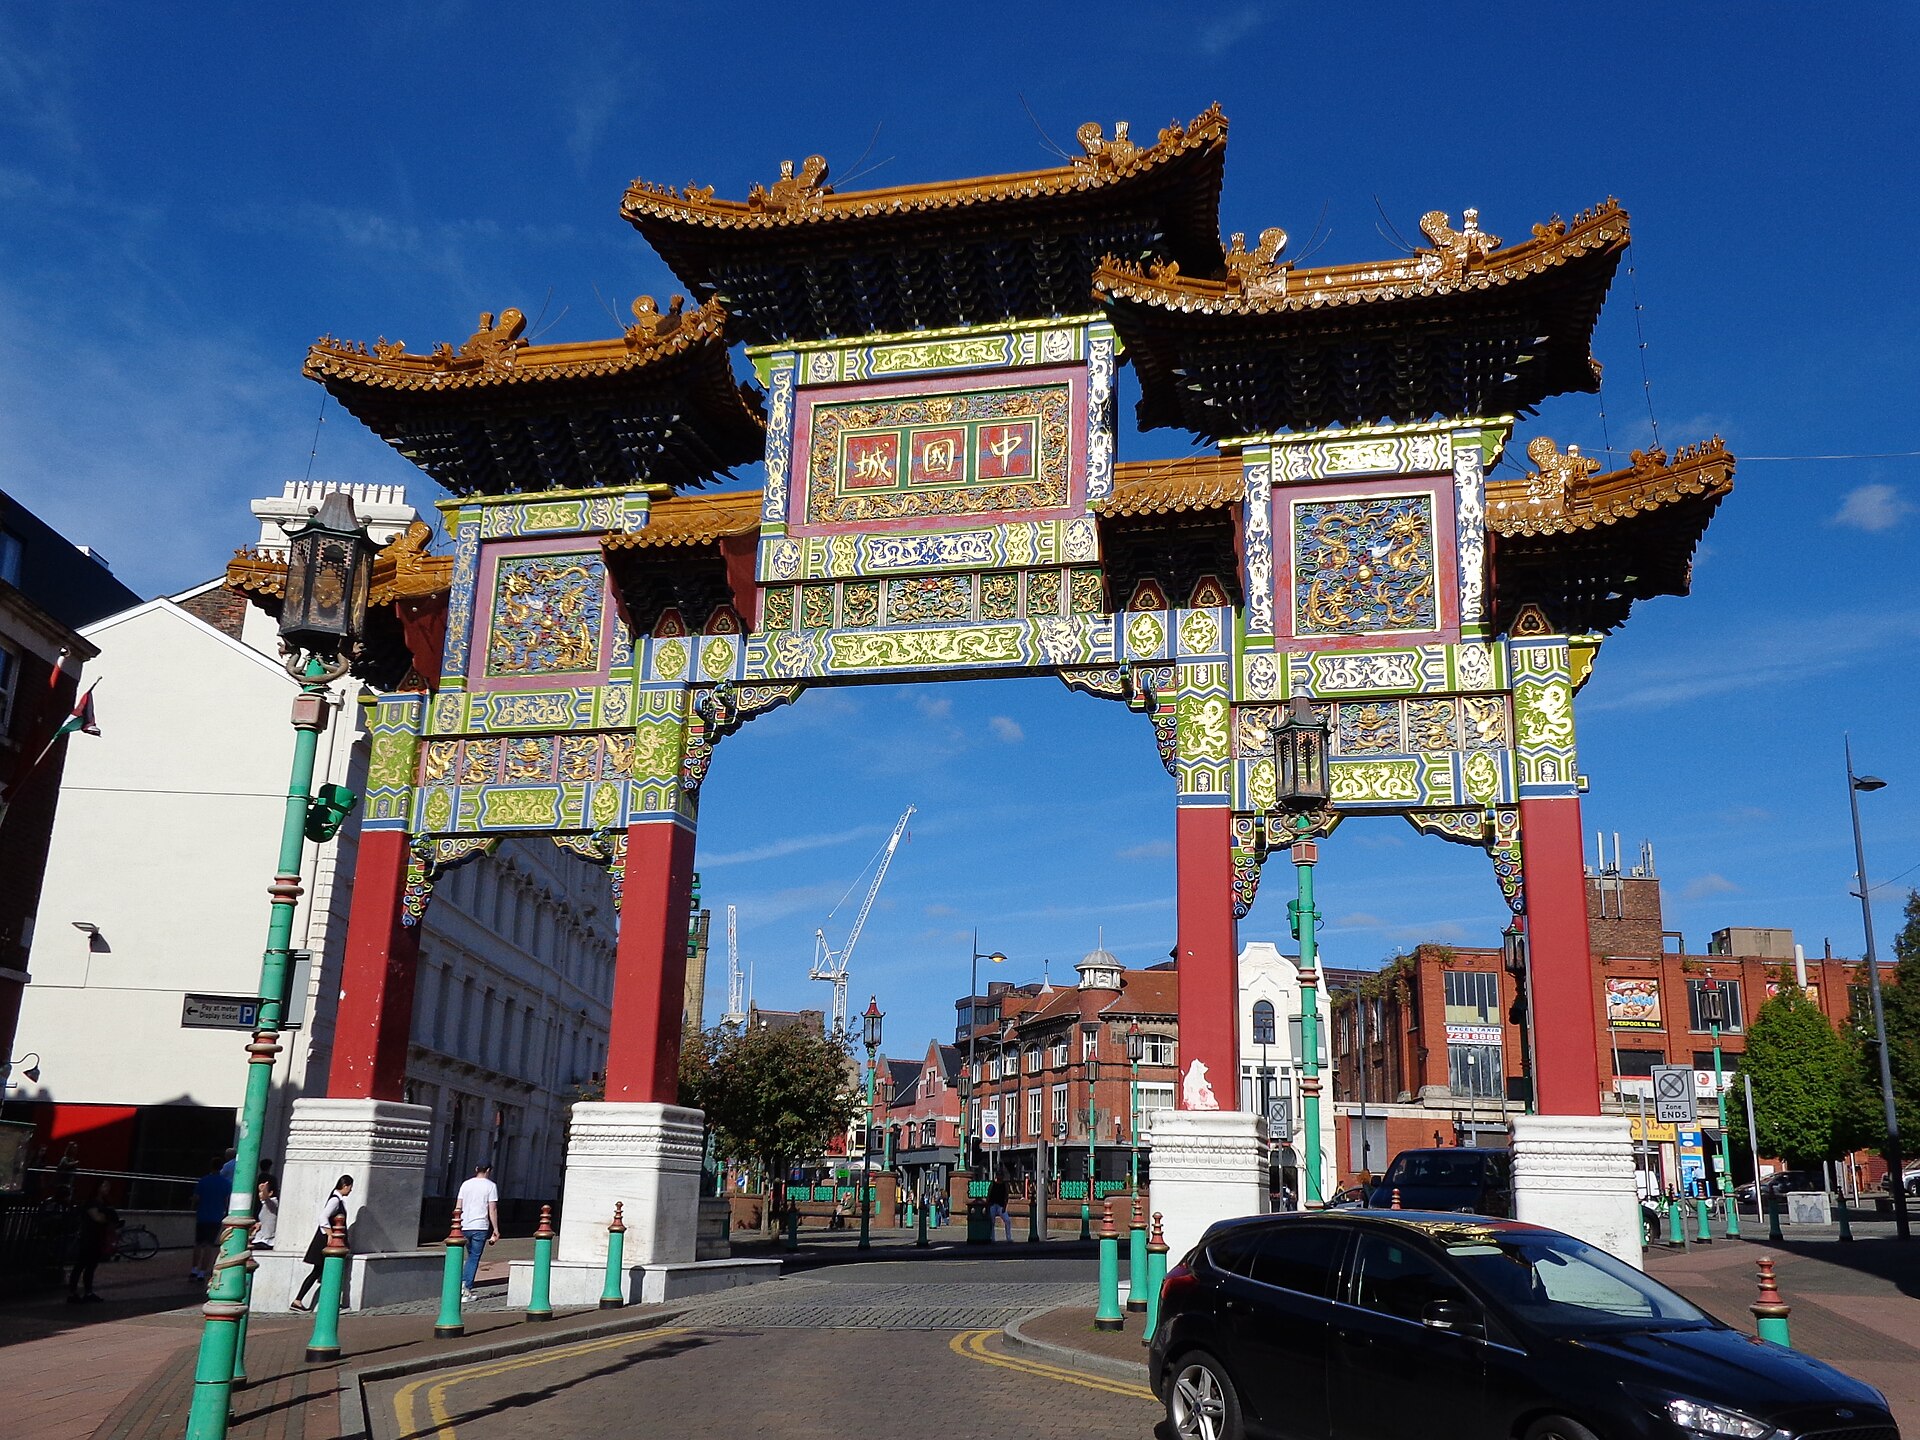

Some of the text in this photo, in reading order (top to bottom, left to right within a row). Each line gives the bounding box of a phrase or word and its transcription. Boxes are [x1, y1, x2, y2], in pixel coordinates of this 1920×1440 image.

[201, 1003, 212, 1012] Pay
[199, 1011, 239, 1020] Display ticket
[244, 1007, 254, 1022] P
[1661, 1111, 1687, 1119] ENDS
